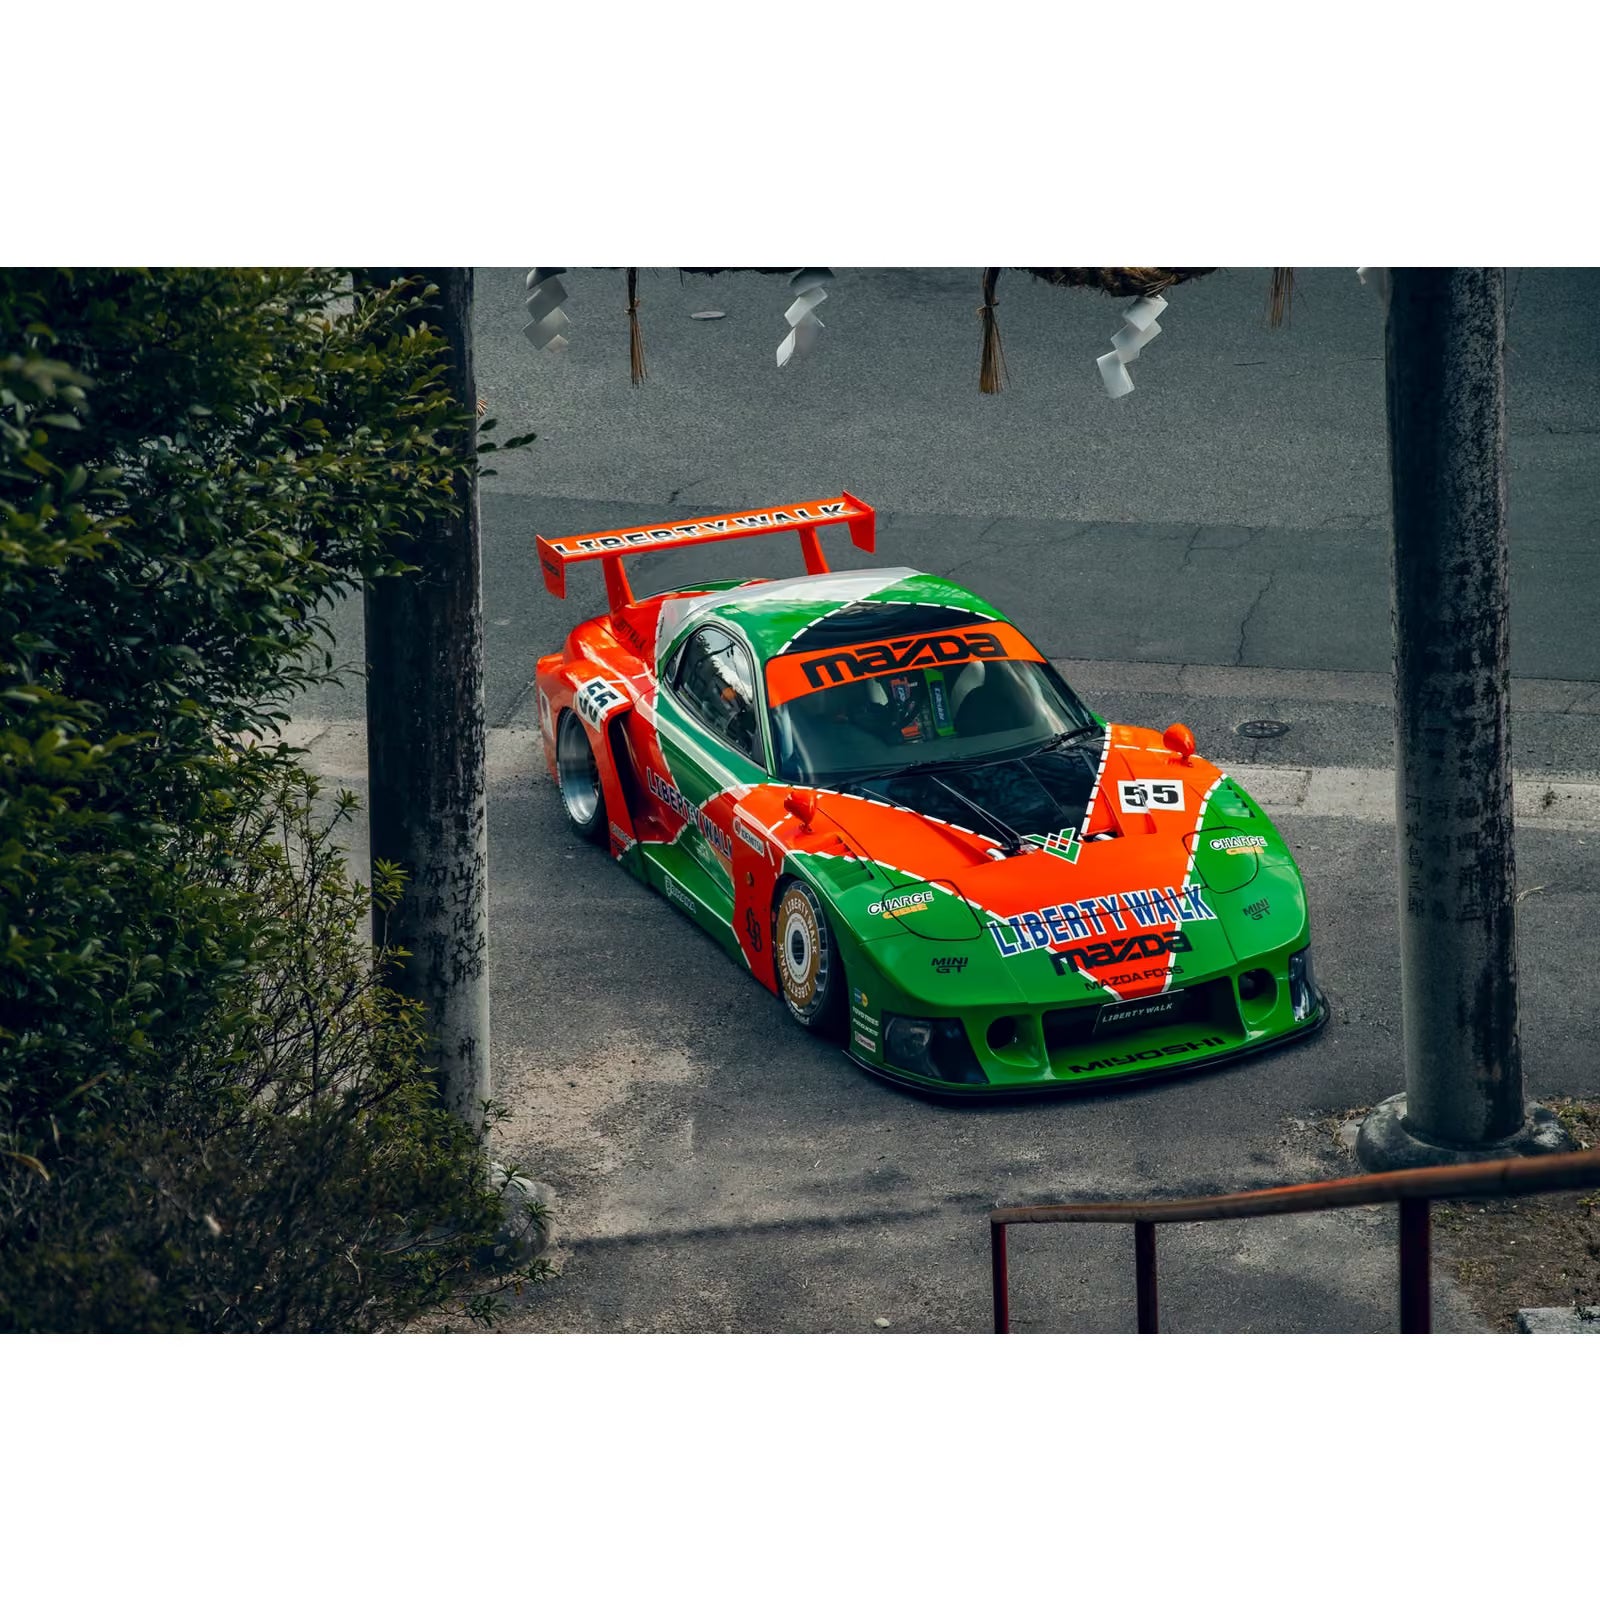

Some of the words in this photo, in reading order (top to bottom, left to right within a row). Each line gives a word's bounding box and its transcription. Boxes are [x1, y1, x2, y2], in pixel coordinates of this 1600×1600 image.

[551, 519, 729, 556] LIBERTY
[735, 502, 850, 527] WALK
[646, 766, 702, 833] LIBERTY
[1124, 784, 1179, 807] 55
[1209, 835, 1268, 851] CHARGE
[868, 891, 934, 915] CHARGE
[1242, 898, 1270, 916] MINI
[785, 898, 808, 917] LIBERTY
[807, 914, 817, 954] WALK
[987, 894, 1128, 958] LIBERTY
[1120, 883, 1218, 927] WALK
[779, 943, 789, 980] WALK
[931, 957, 969, 966] MINI
[936, 964, 967, 974] GT
[787, 981, 811, 999] LIBERTY
[1084, 973, 1144, 992] MAZDA
[1144, 965, 1184, 980] FD3S
[1102, 1009, 1145, 1023] LIBERTY
[1146, 1003, 1173, 1014] WALK
[1067, 1037, 1227, 1074] MIYOSHI
